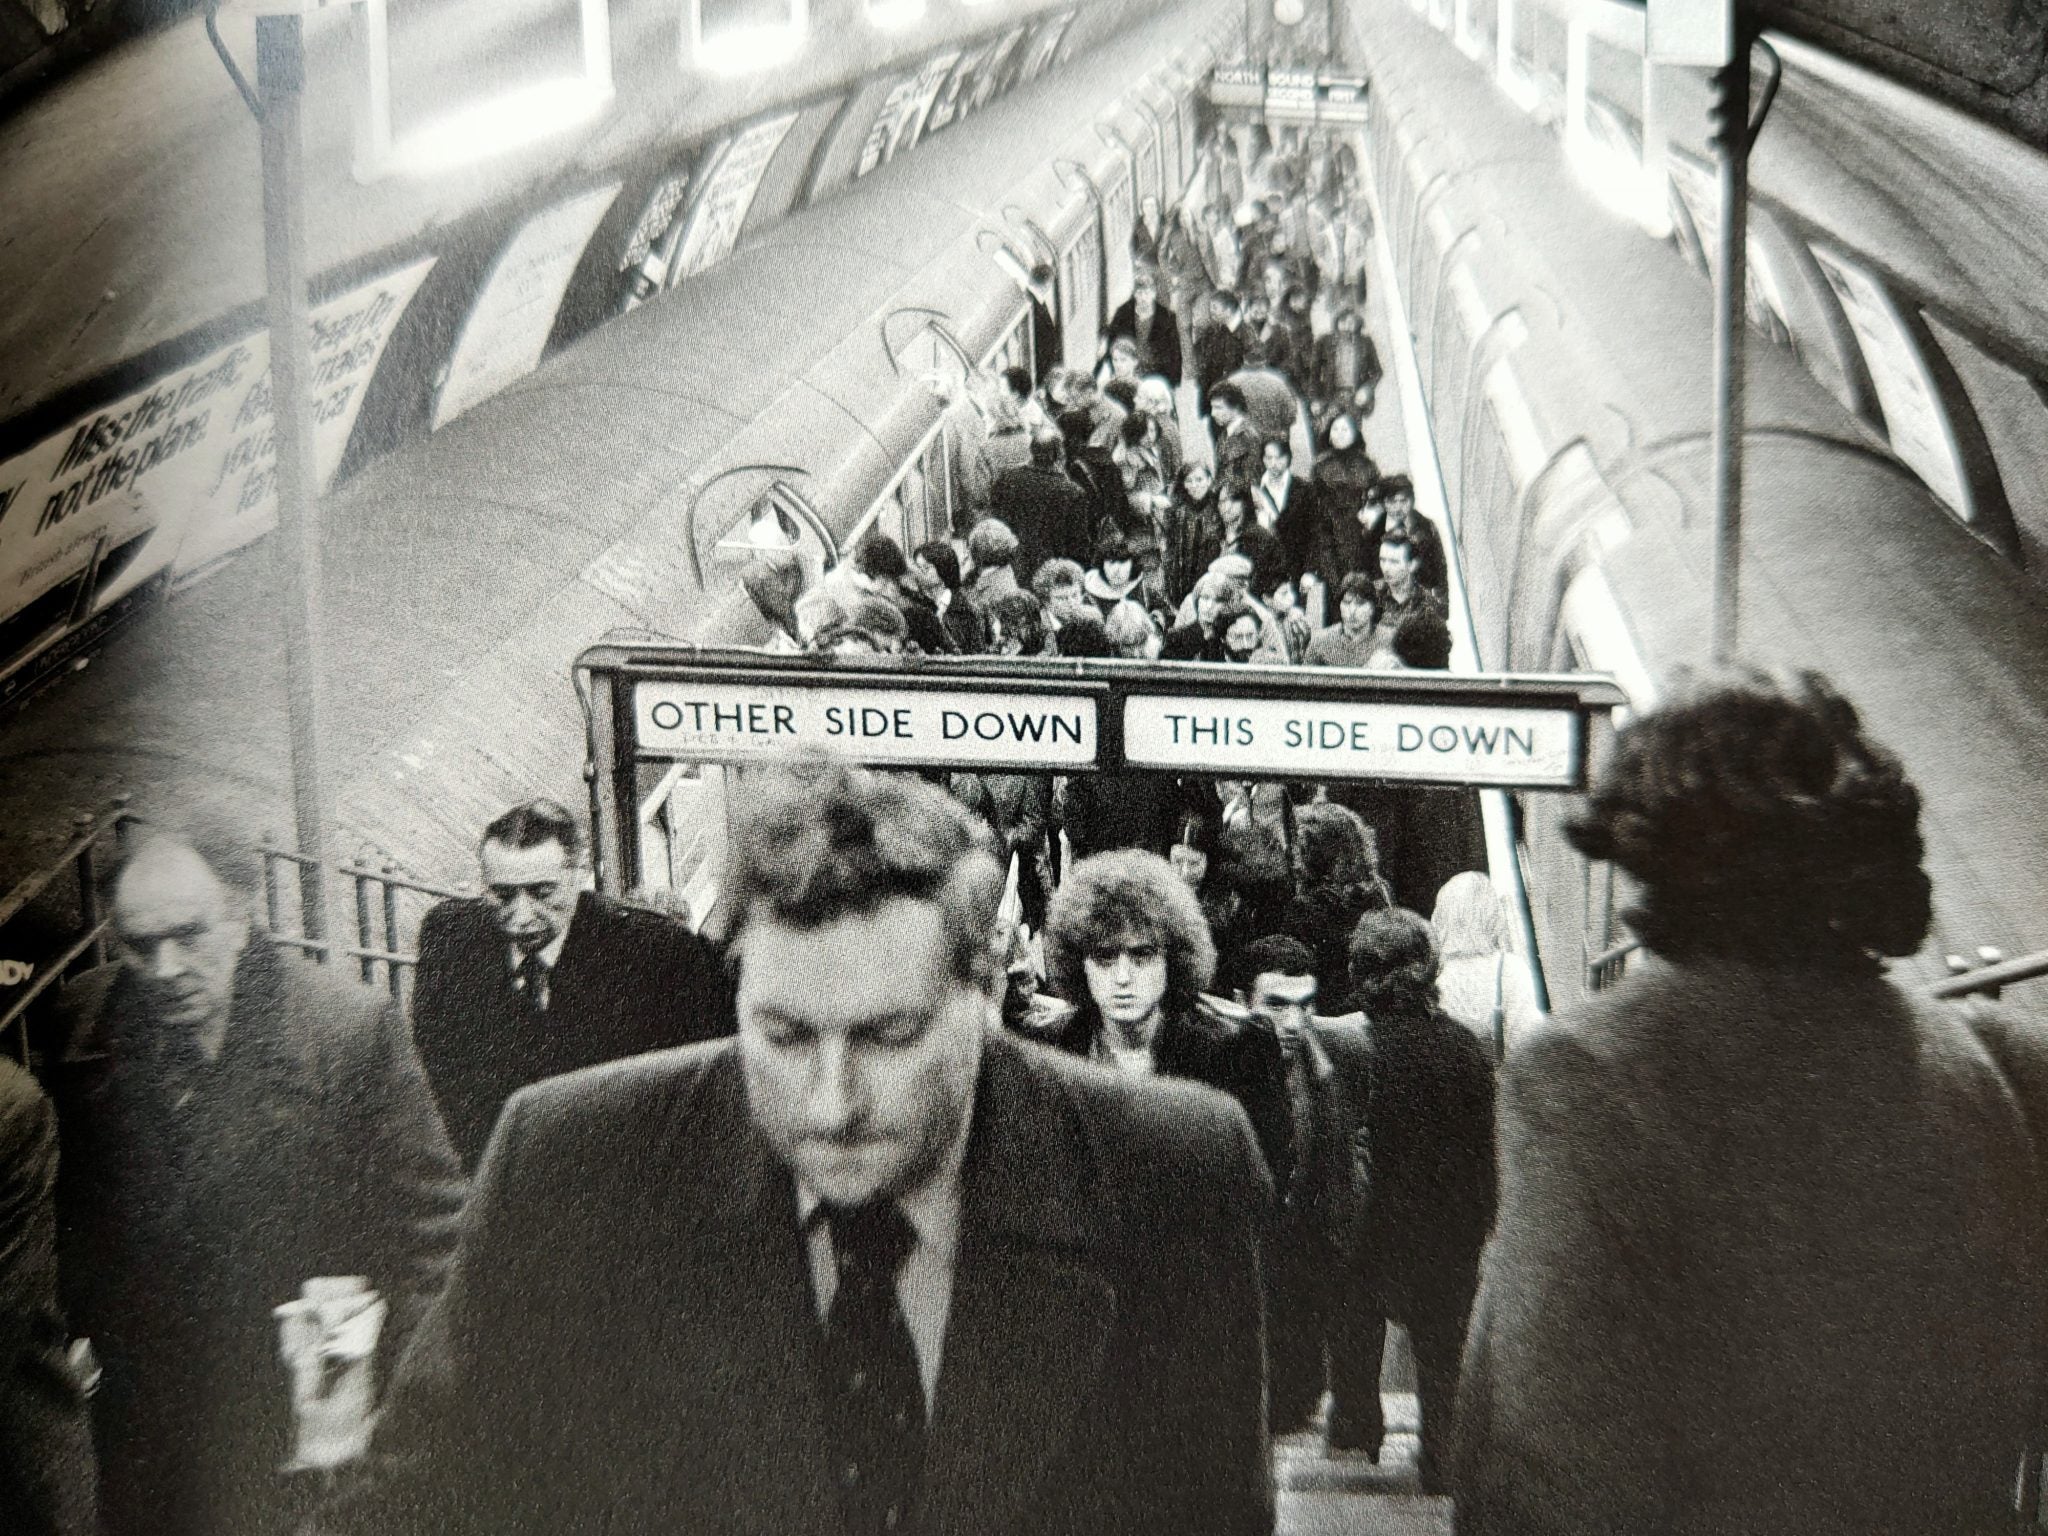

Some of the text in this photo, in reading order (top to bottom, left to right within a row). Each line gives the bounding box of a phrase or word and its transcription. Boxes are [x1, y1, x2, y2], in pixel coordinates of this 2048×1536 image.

[50, 412, 131, 482] Miss
[123, 386, 176, 442] the
[34, 465, 96, 537] not
[88, 447, 137, 504] the
[651, 701, 1083, 745] OTHER SIDE DOWN
[1164, 714, 1534, 756] THIS SIDE DOWN
